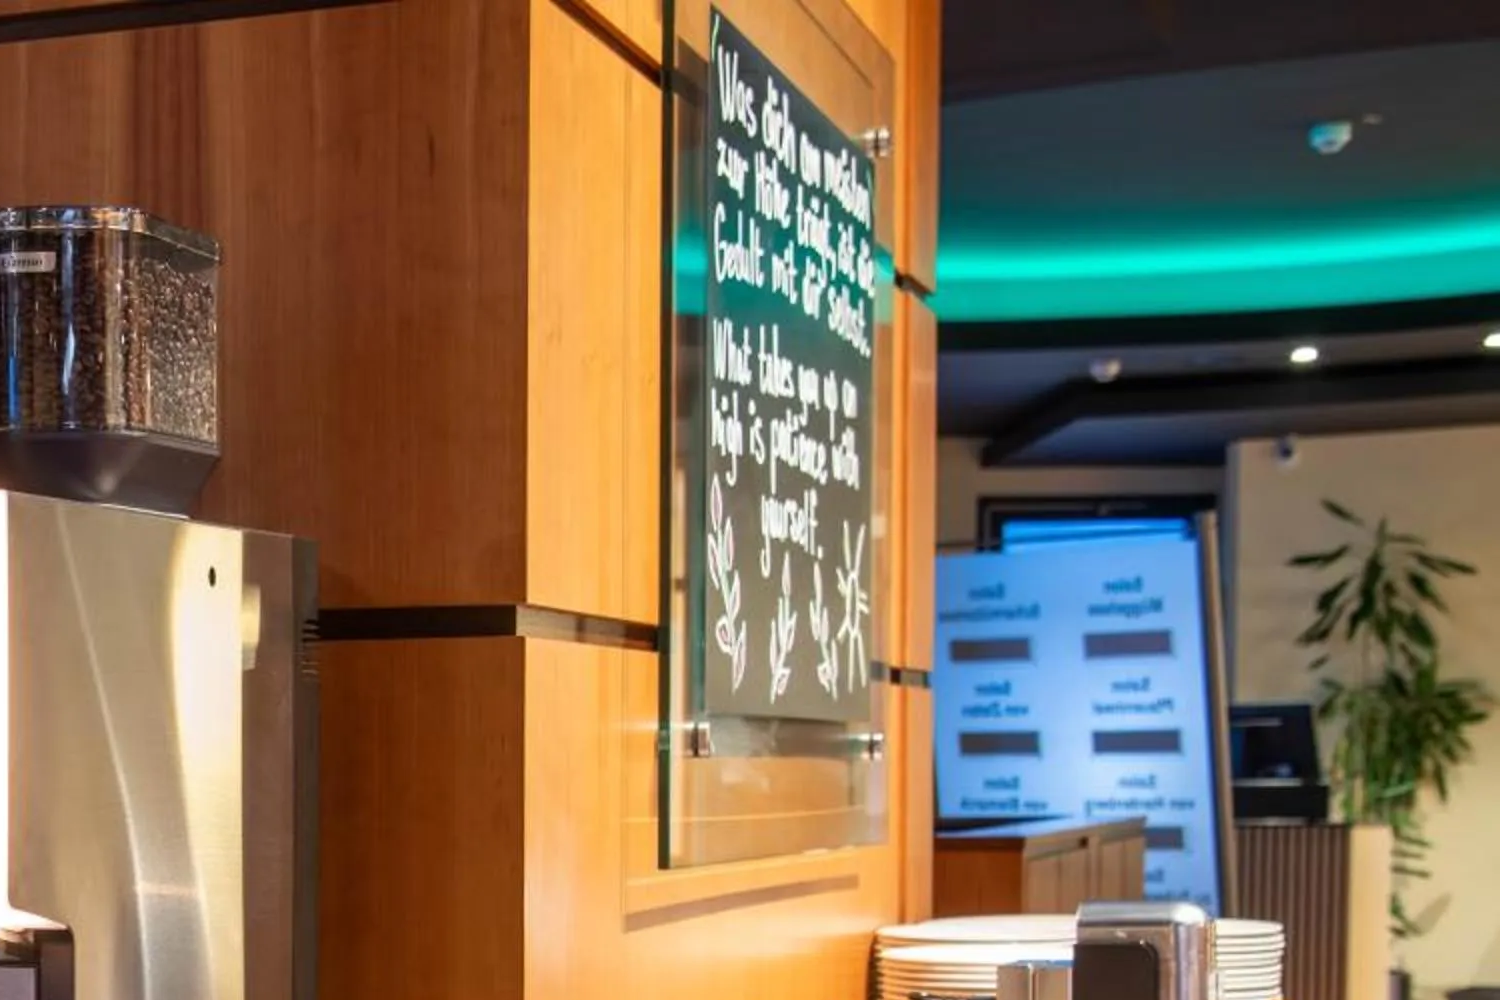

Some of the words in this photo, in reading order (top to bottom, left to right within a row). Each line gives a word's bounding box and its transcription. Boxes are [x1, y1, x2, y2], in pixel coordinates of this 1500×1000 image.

[717, 44, 758, 138] Was
[761, 75, 797, 174] dich
[716, 136, 750, 200] zur
[754, 150, 791, 229] Höhe
[837, 221, 856, 283] ist
[771, 239, 798, 305] mit
[802, 256, 822, 320] dir
[711, 317, 753, 386] What
[758, 323, 795, 398] takes
[798, 363, 821, 426] you
[822, 370, 839, 442] up
[841, 378, 858, 419] on
[710, 387, 744, 487] high
[747, 399, 765, 465] is
[831, 425, 861, 491] with
[760, 488, 824, 578] yourself.
